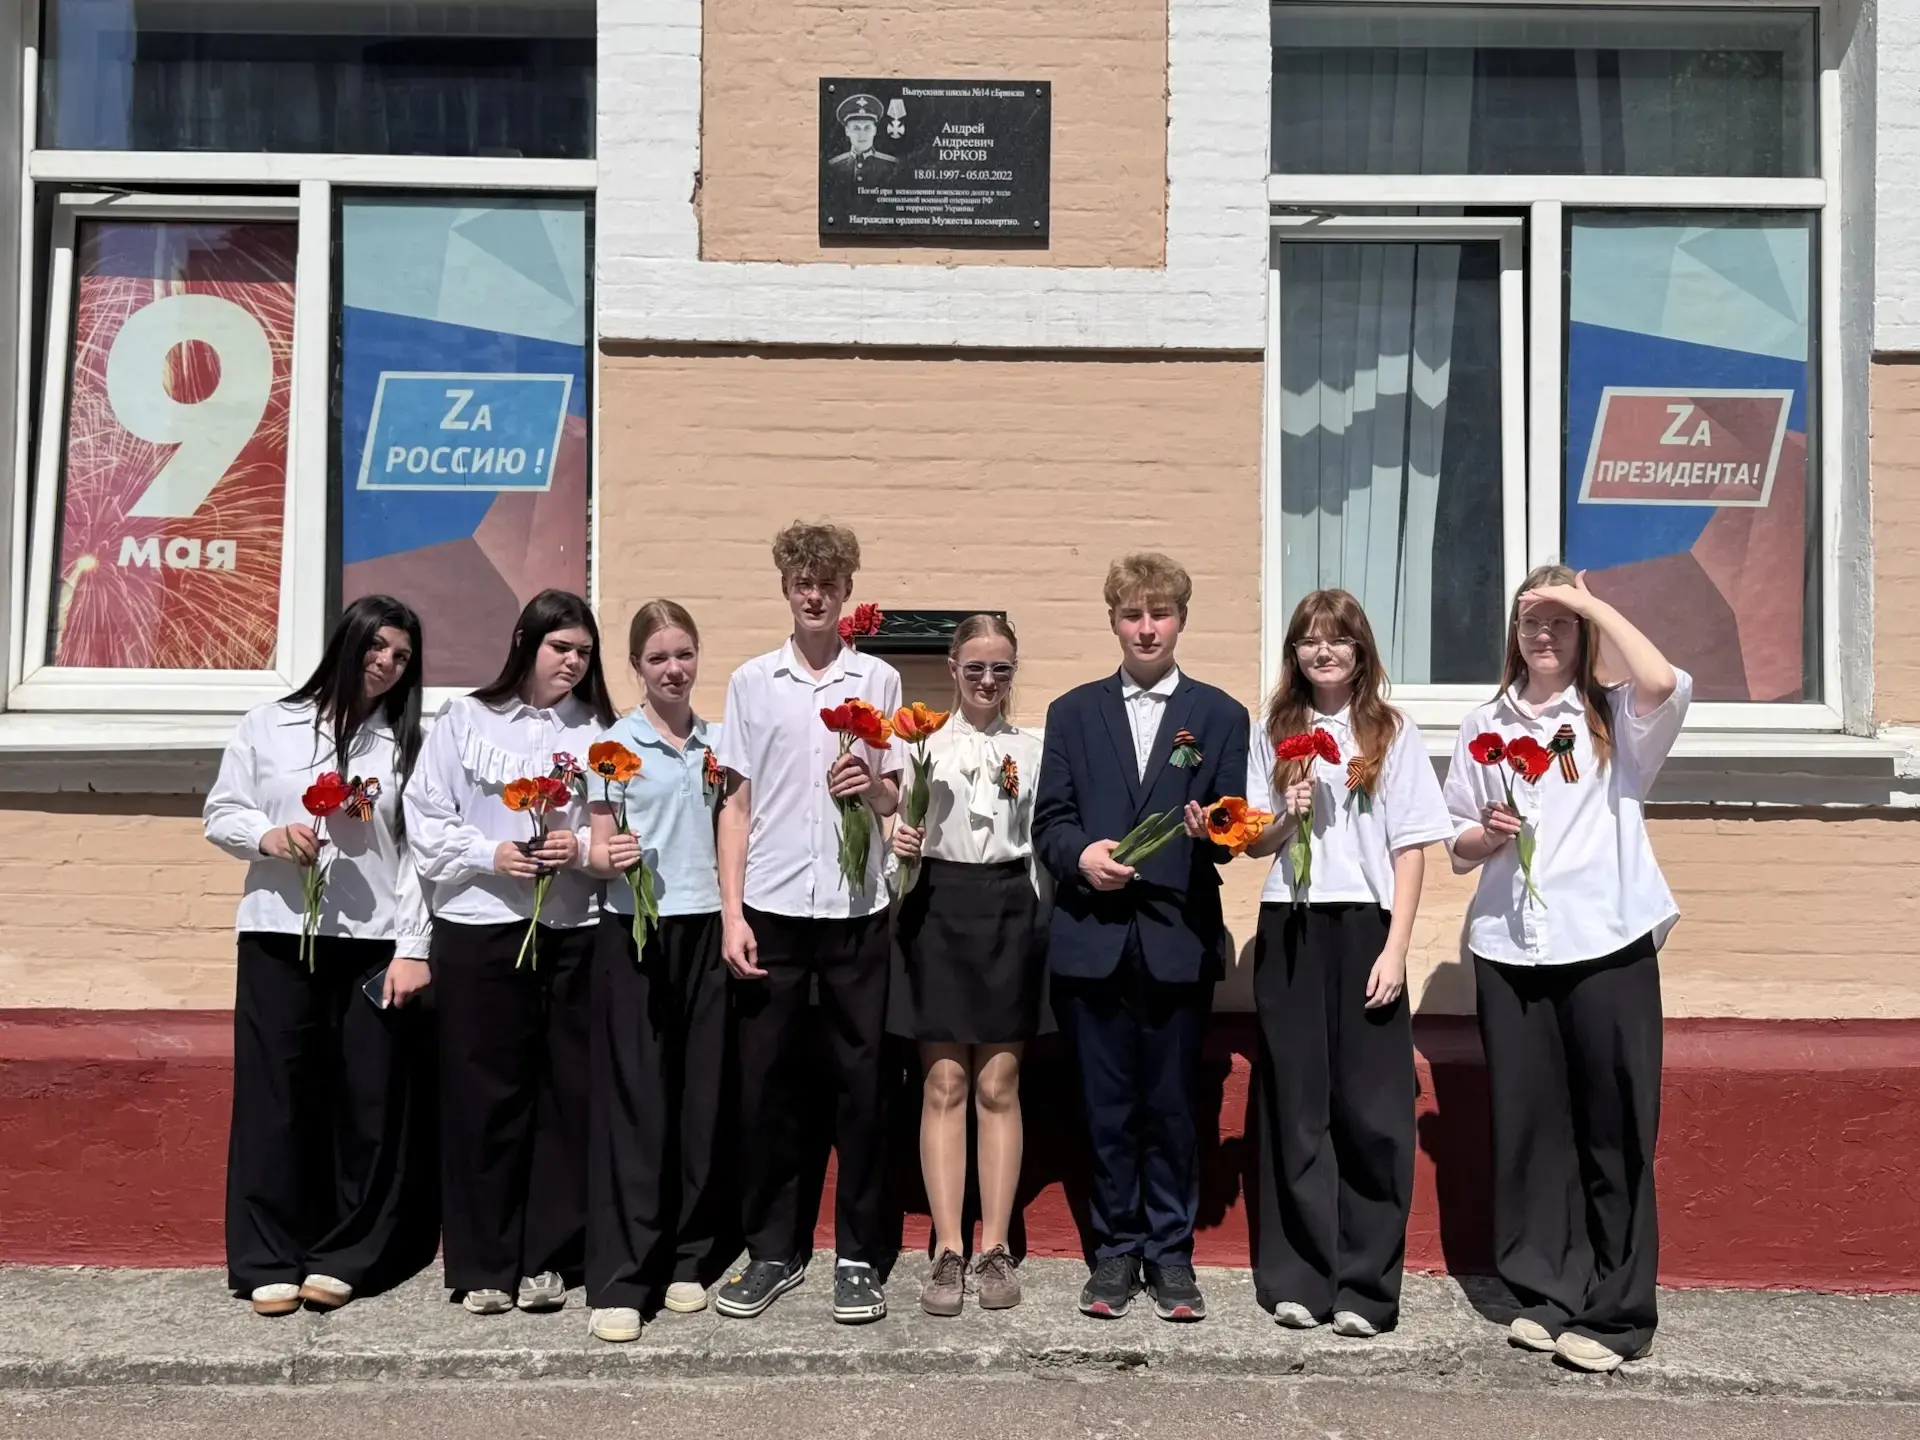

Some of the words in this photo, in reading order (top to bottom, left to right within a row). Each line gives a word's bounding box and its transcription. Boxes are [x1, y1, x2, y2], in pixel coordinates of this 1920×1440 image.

[902, 87, 944, 98] Выпускник
[945, 88, 971, 97] школы
[972, 88, 989, 97] №14
[942, 122, 985, 136] Андрей
[932, 136, 994, 149] Андреевич
[939, 149, 987, 161] ЮРКОВ
[914, 169, 959, 180] 18.01.1997
[966, 170, 1013, 181] 05.03.2022
[857, 186, 879, 195] Погиб
[880, 188, 893, 196] при
[876, 196, 920, 204] специальной
[921, 196, 949, 204] военной
[949, 197, 980, 205] операции
[982, 196, 994, 204] РФ
[905, 205, 943, 213] территории
[944, 204, 974, 213] Украины
[849, 214, 894, 226] Награжден
[895, 217, 930, 226] орденом
[931, 215, 973, 227] Мужества
[974, 218, 1020, 228] посмертно.
[106, 293, 274, 518] 9
[1596, 460, 1761, 488] ПРЕЗИДЕНТА!
[117, 535, 238, 570] мая
